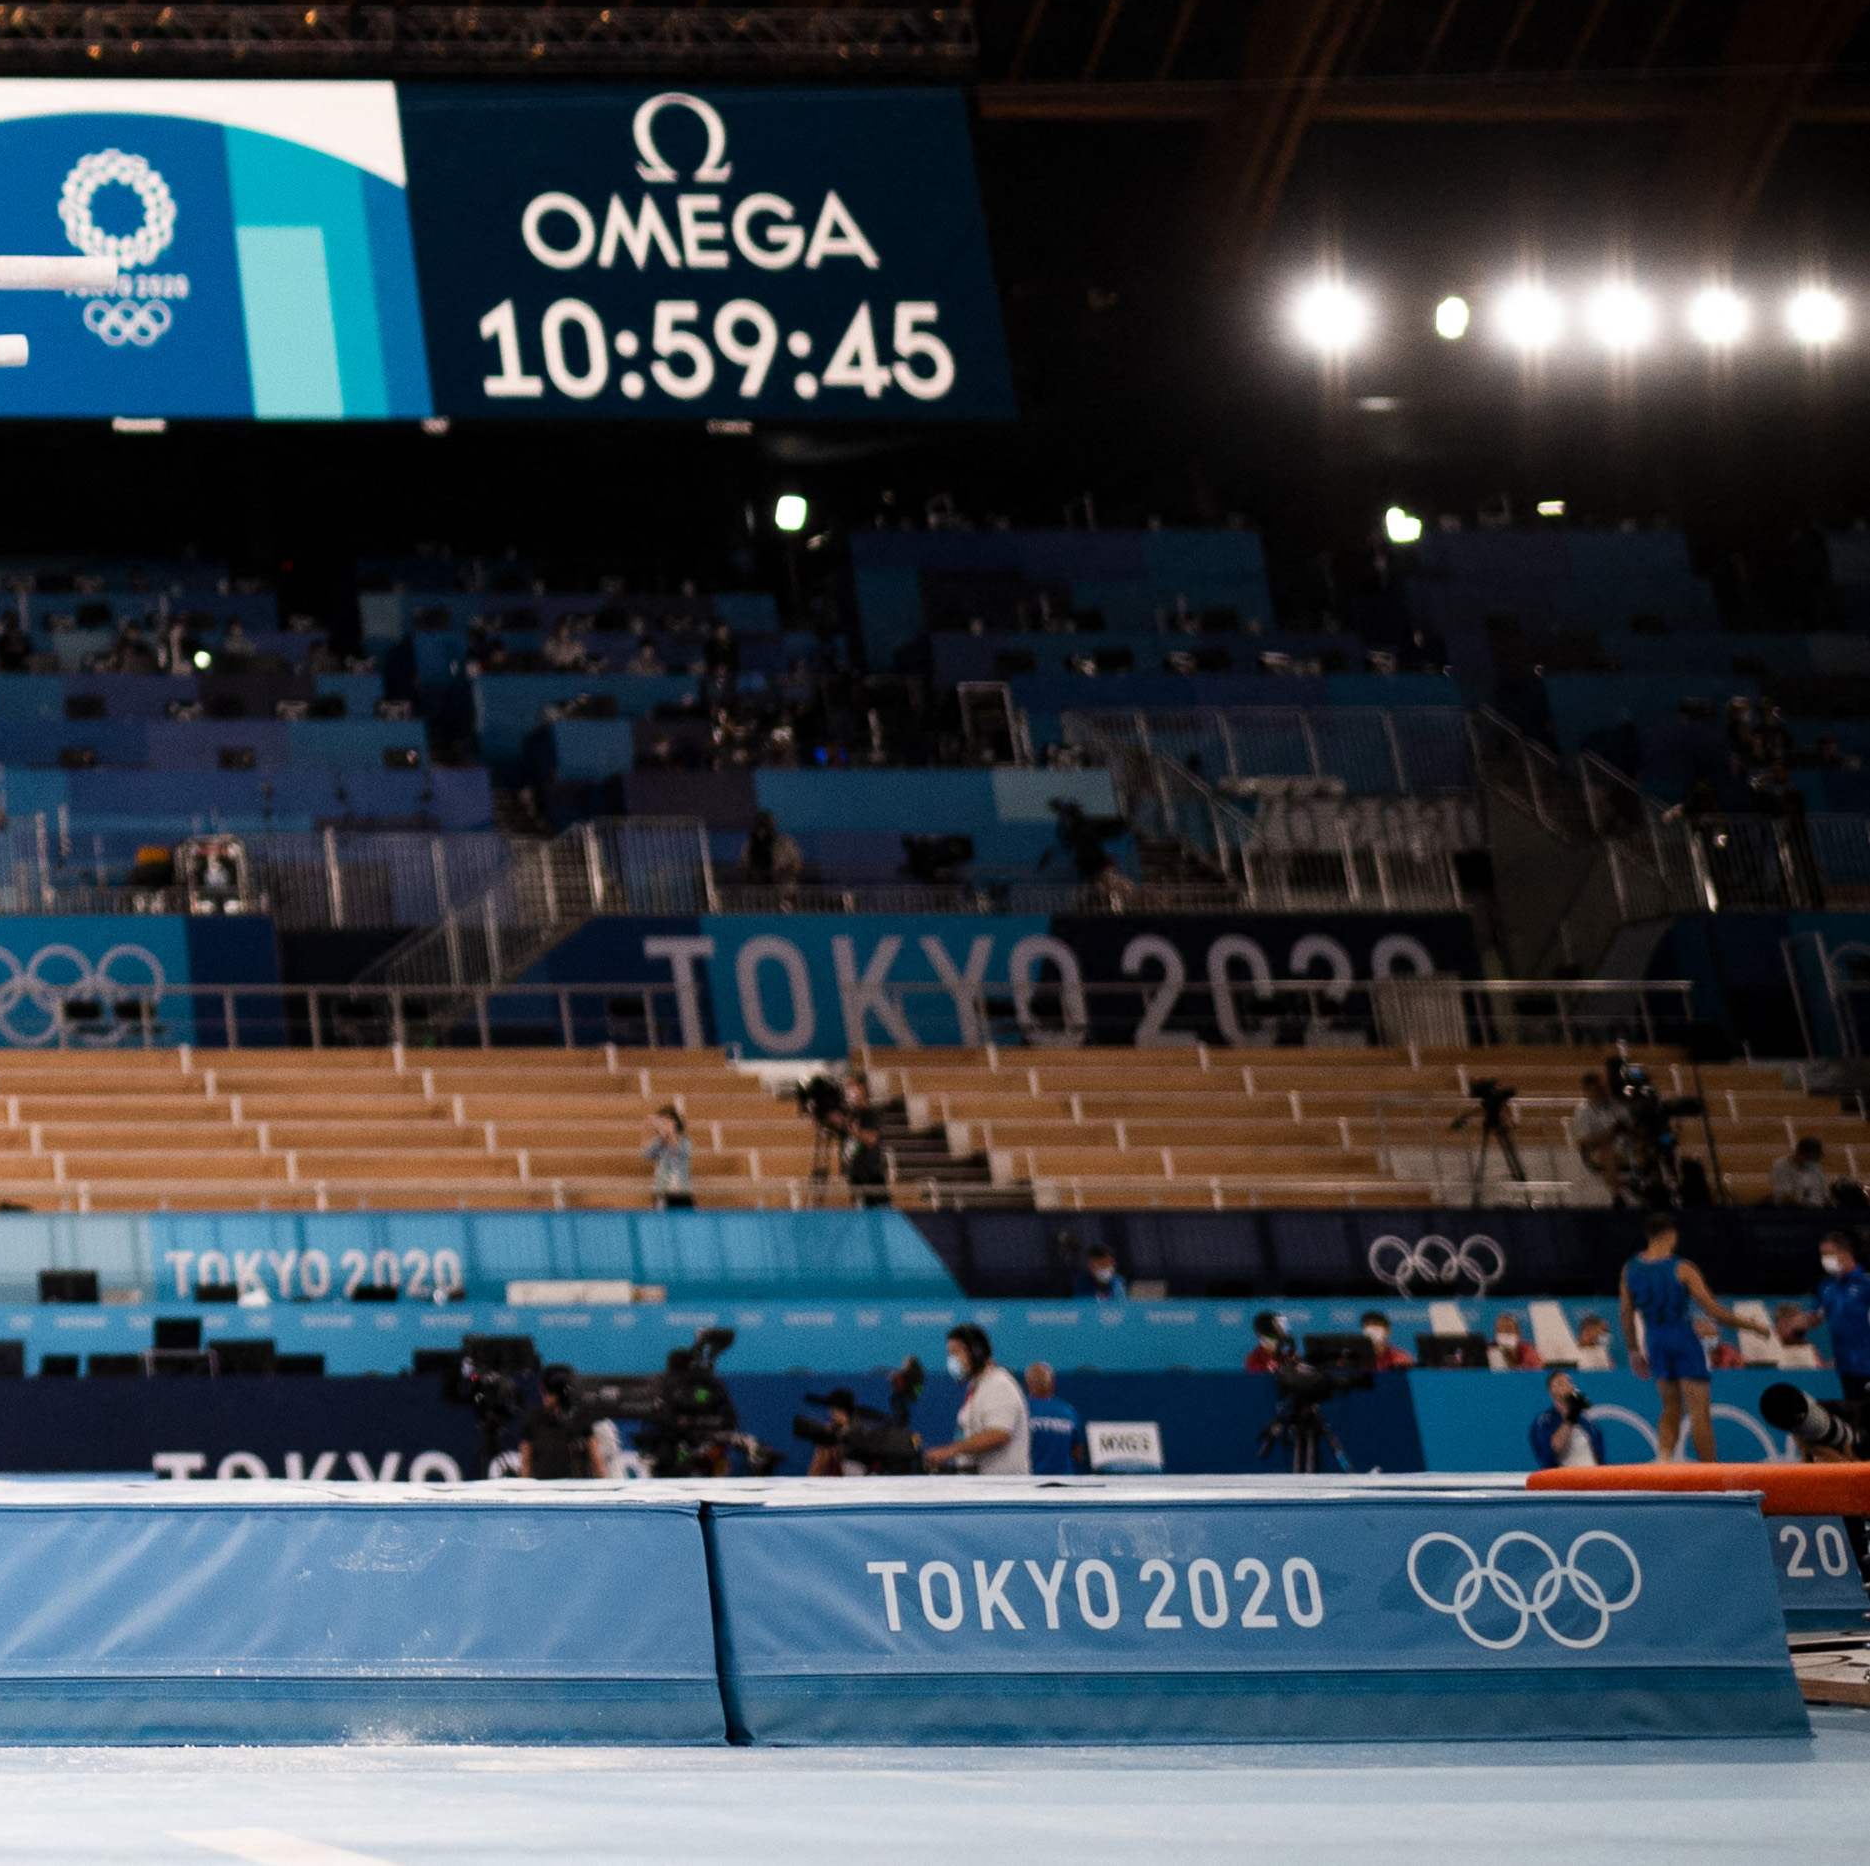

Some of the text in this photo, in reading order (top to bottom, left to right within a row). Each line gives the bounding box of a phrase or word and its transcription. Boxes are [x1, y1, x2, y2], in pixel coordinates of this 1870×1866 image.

[522, 190, 880, 269] OMEGA
[478, 298, 955, 399] 10:59:45
[644, 935, 1087, 1052] TOKYO
[164, 1248, 331, 1298] TOKYO
[866, 1556, 1325, 1632] TOKYO 2020
